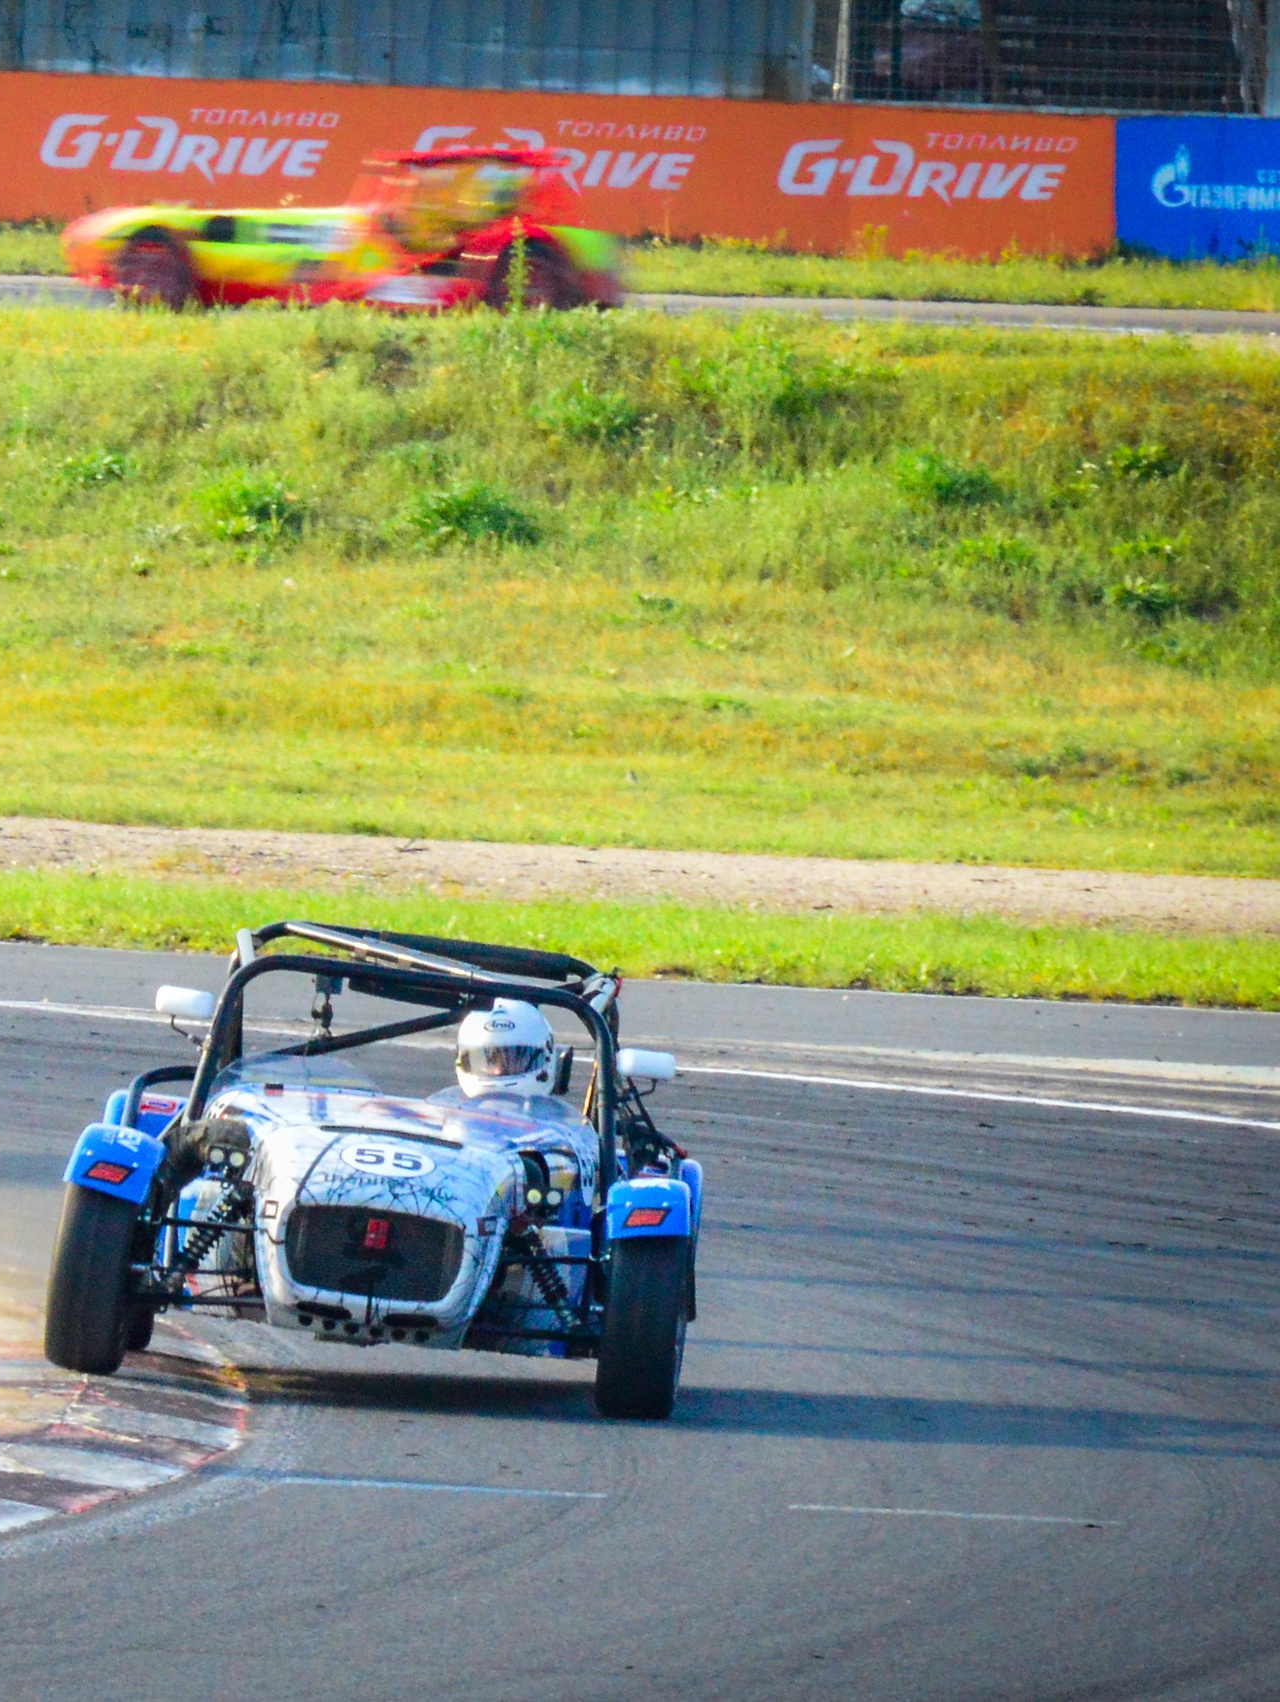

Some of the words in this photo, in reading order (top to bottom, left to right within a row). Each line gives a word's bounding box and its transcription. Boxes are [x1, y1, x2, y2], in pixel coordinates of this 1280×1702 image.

[190, 108, 340, 129] ТОПЛИВО
[557, 120, 706, 142] ТОПЛИВО
[926, 132, 1078, 153] ТОПЛИВО
[354, 1148, 422, 1171] 55
